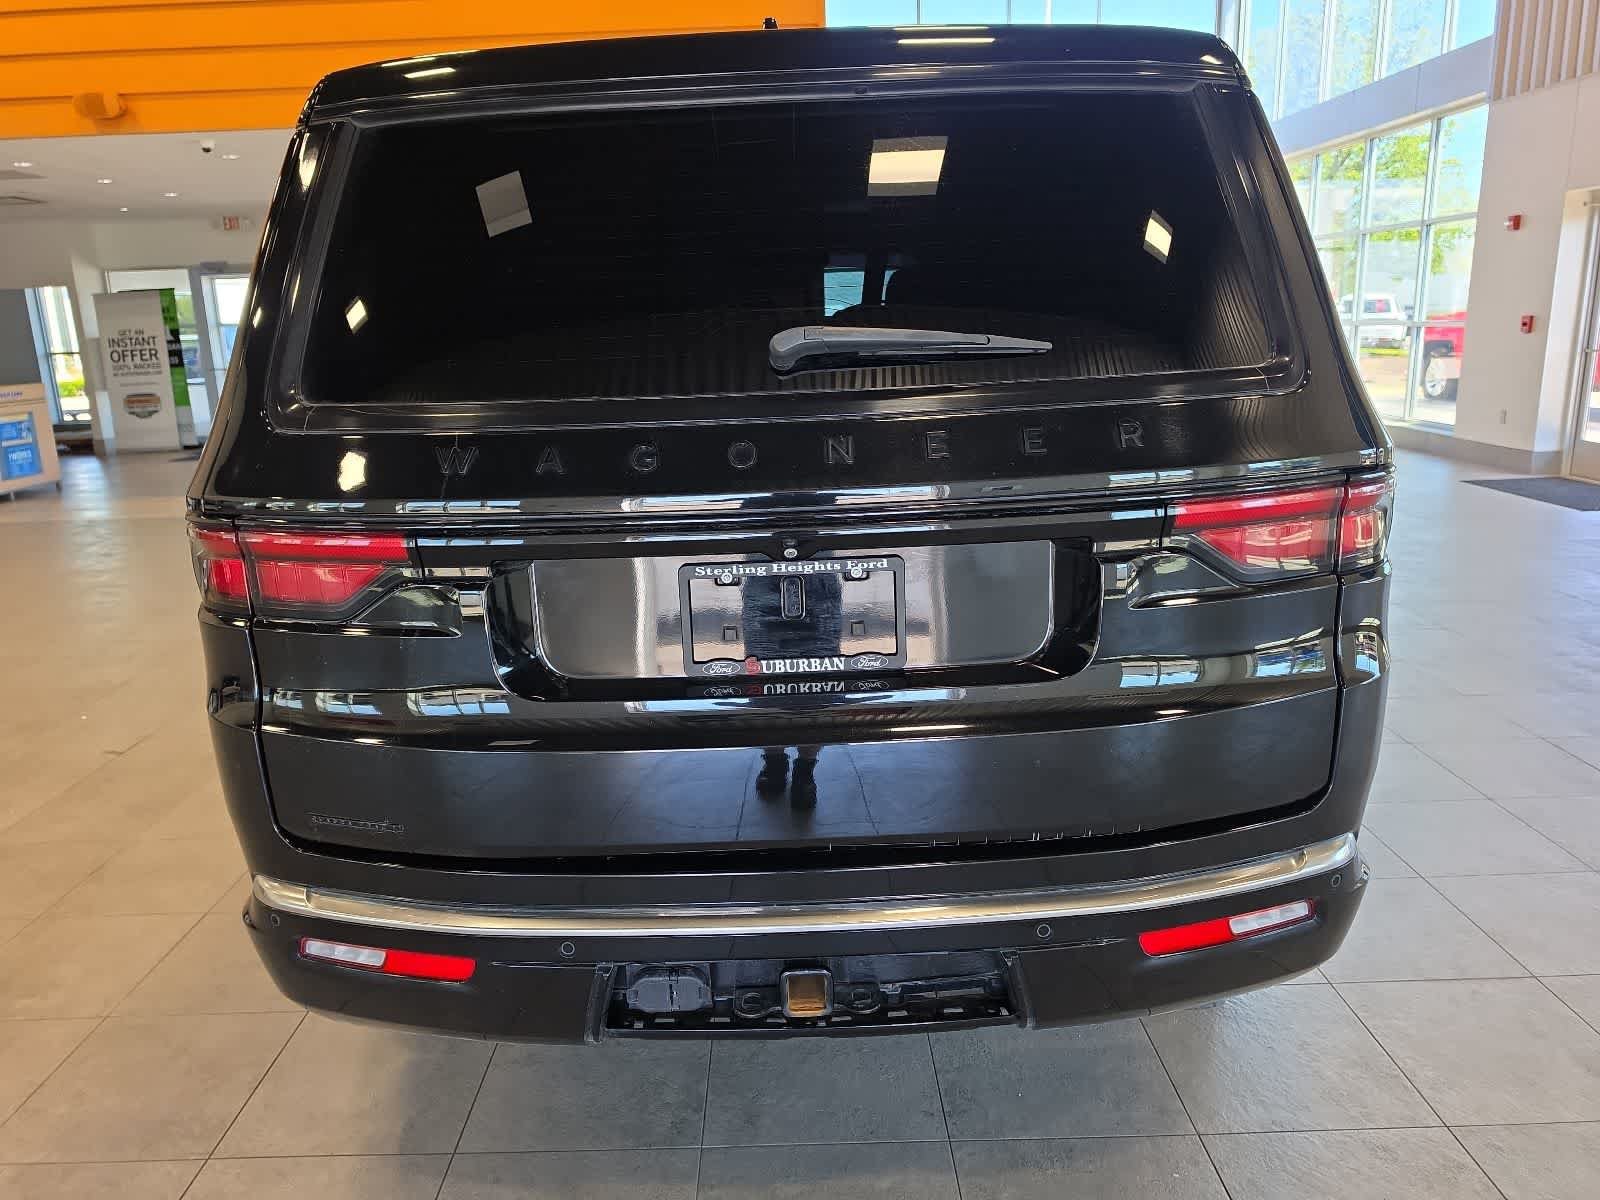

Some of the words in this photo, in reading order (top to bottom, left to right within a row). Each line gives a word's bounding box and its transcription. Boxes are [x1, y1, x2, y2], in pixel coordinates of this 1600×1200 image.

[108, 336, 156, 348] INSTANT
[110, 348, 159, 363] OFFER
[435, 418, 1146, 477] WAGONEER
[695, 564, 767, 577] Sterling
[772, 560, 841, 575] Heights
[846, 558, 889, 571] Ford
[708, 661, 735, 674] Ford
[856, 656, 883, 669] Ford
